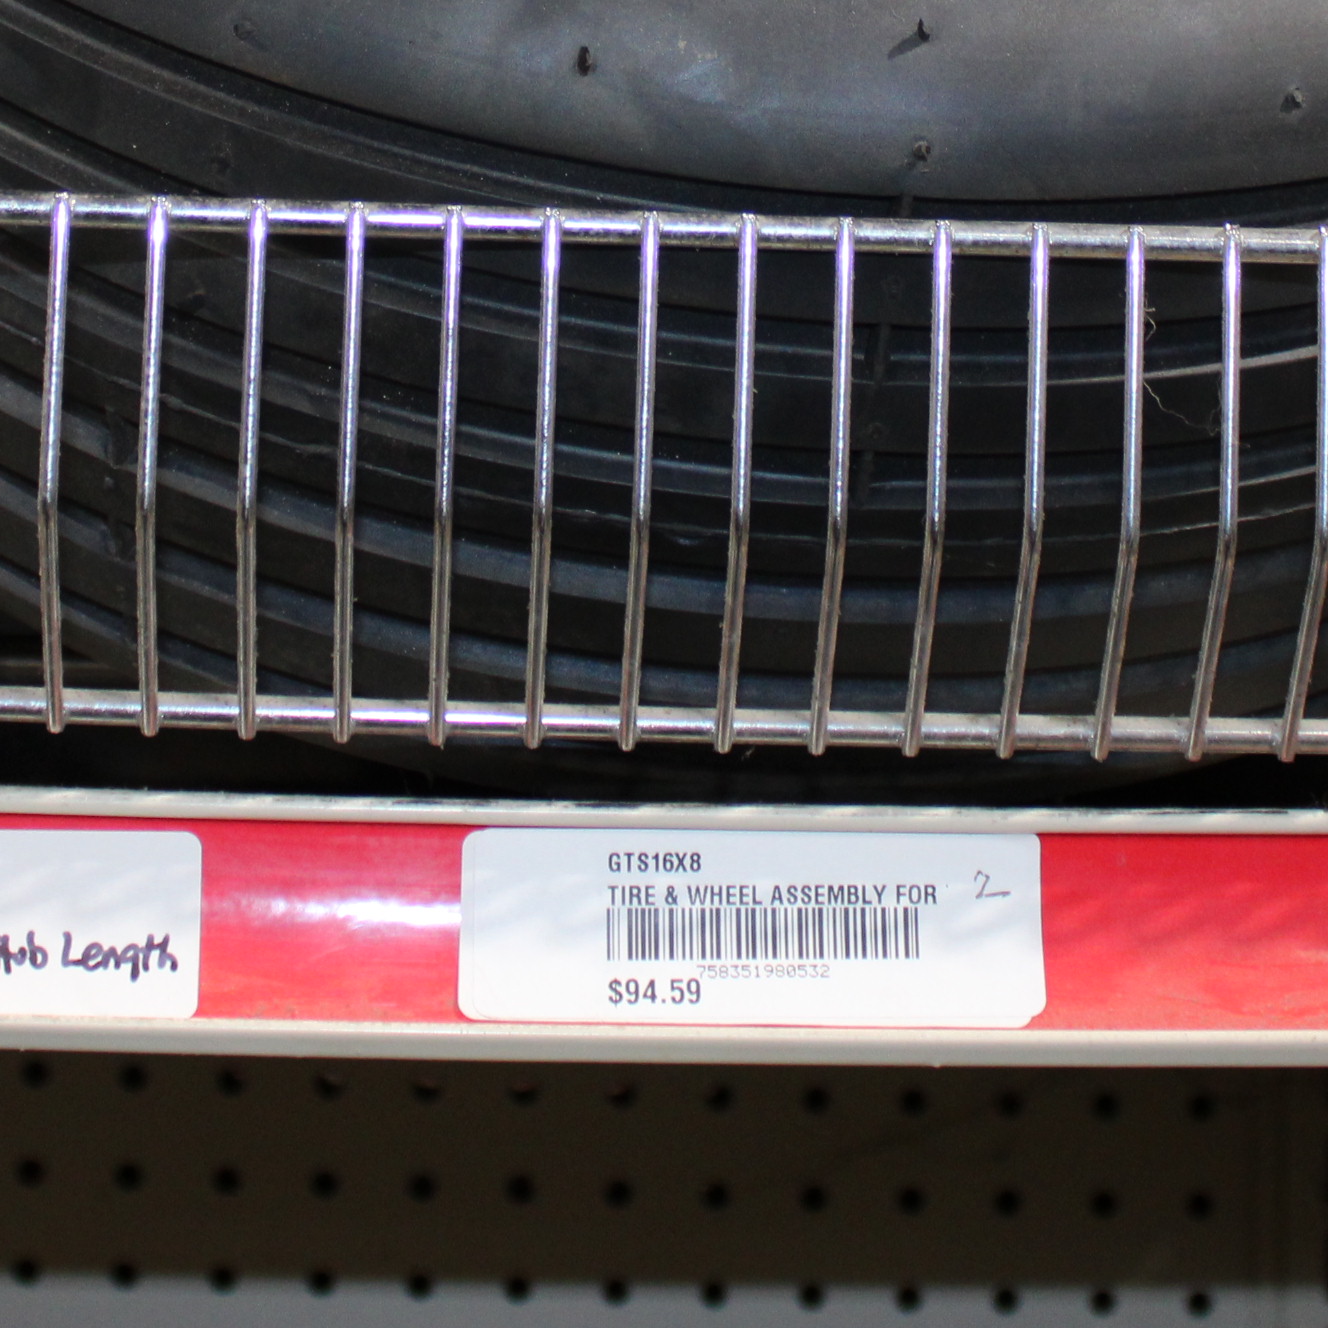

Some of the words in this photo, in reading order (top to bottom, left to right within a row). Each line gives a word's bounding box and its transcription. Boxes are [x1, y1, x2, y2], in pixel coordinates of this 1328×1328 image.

[608, 852, 702, 874] GTS16X8
[609, 885, 656, 907] TIRE
[664, 885, 679, 906] &
[687, 885, 763, 906] WHEEL
[770, 884, 887, 906] ASSEMBLY
[896, 884, 938, 905] FOR
[973, 869, 1012, 900] 2
[61, 932, 178, 982] Length
[695, 963, 832, 980] 758351980532
[608, 978, 702, 1007] $94.59
